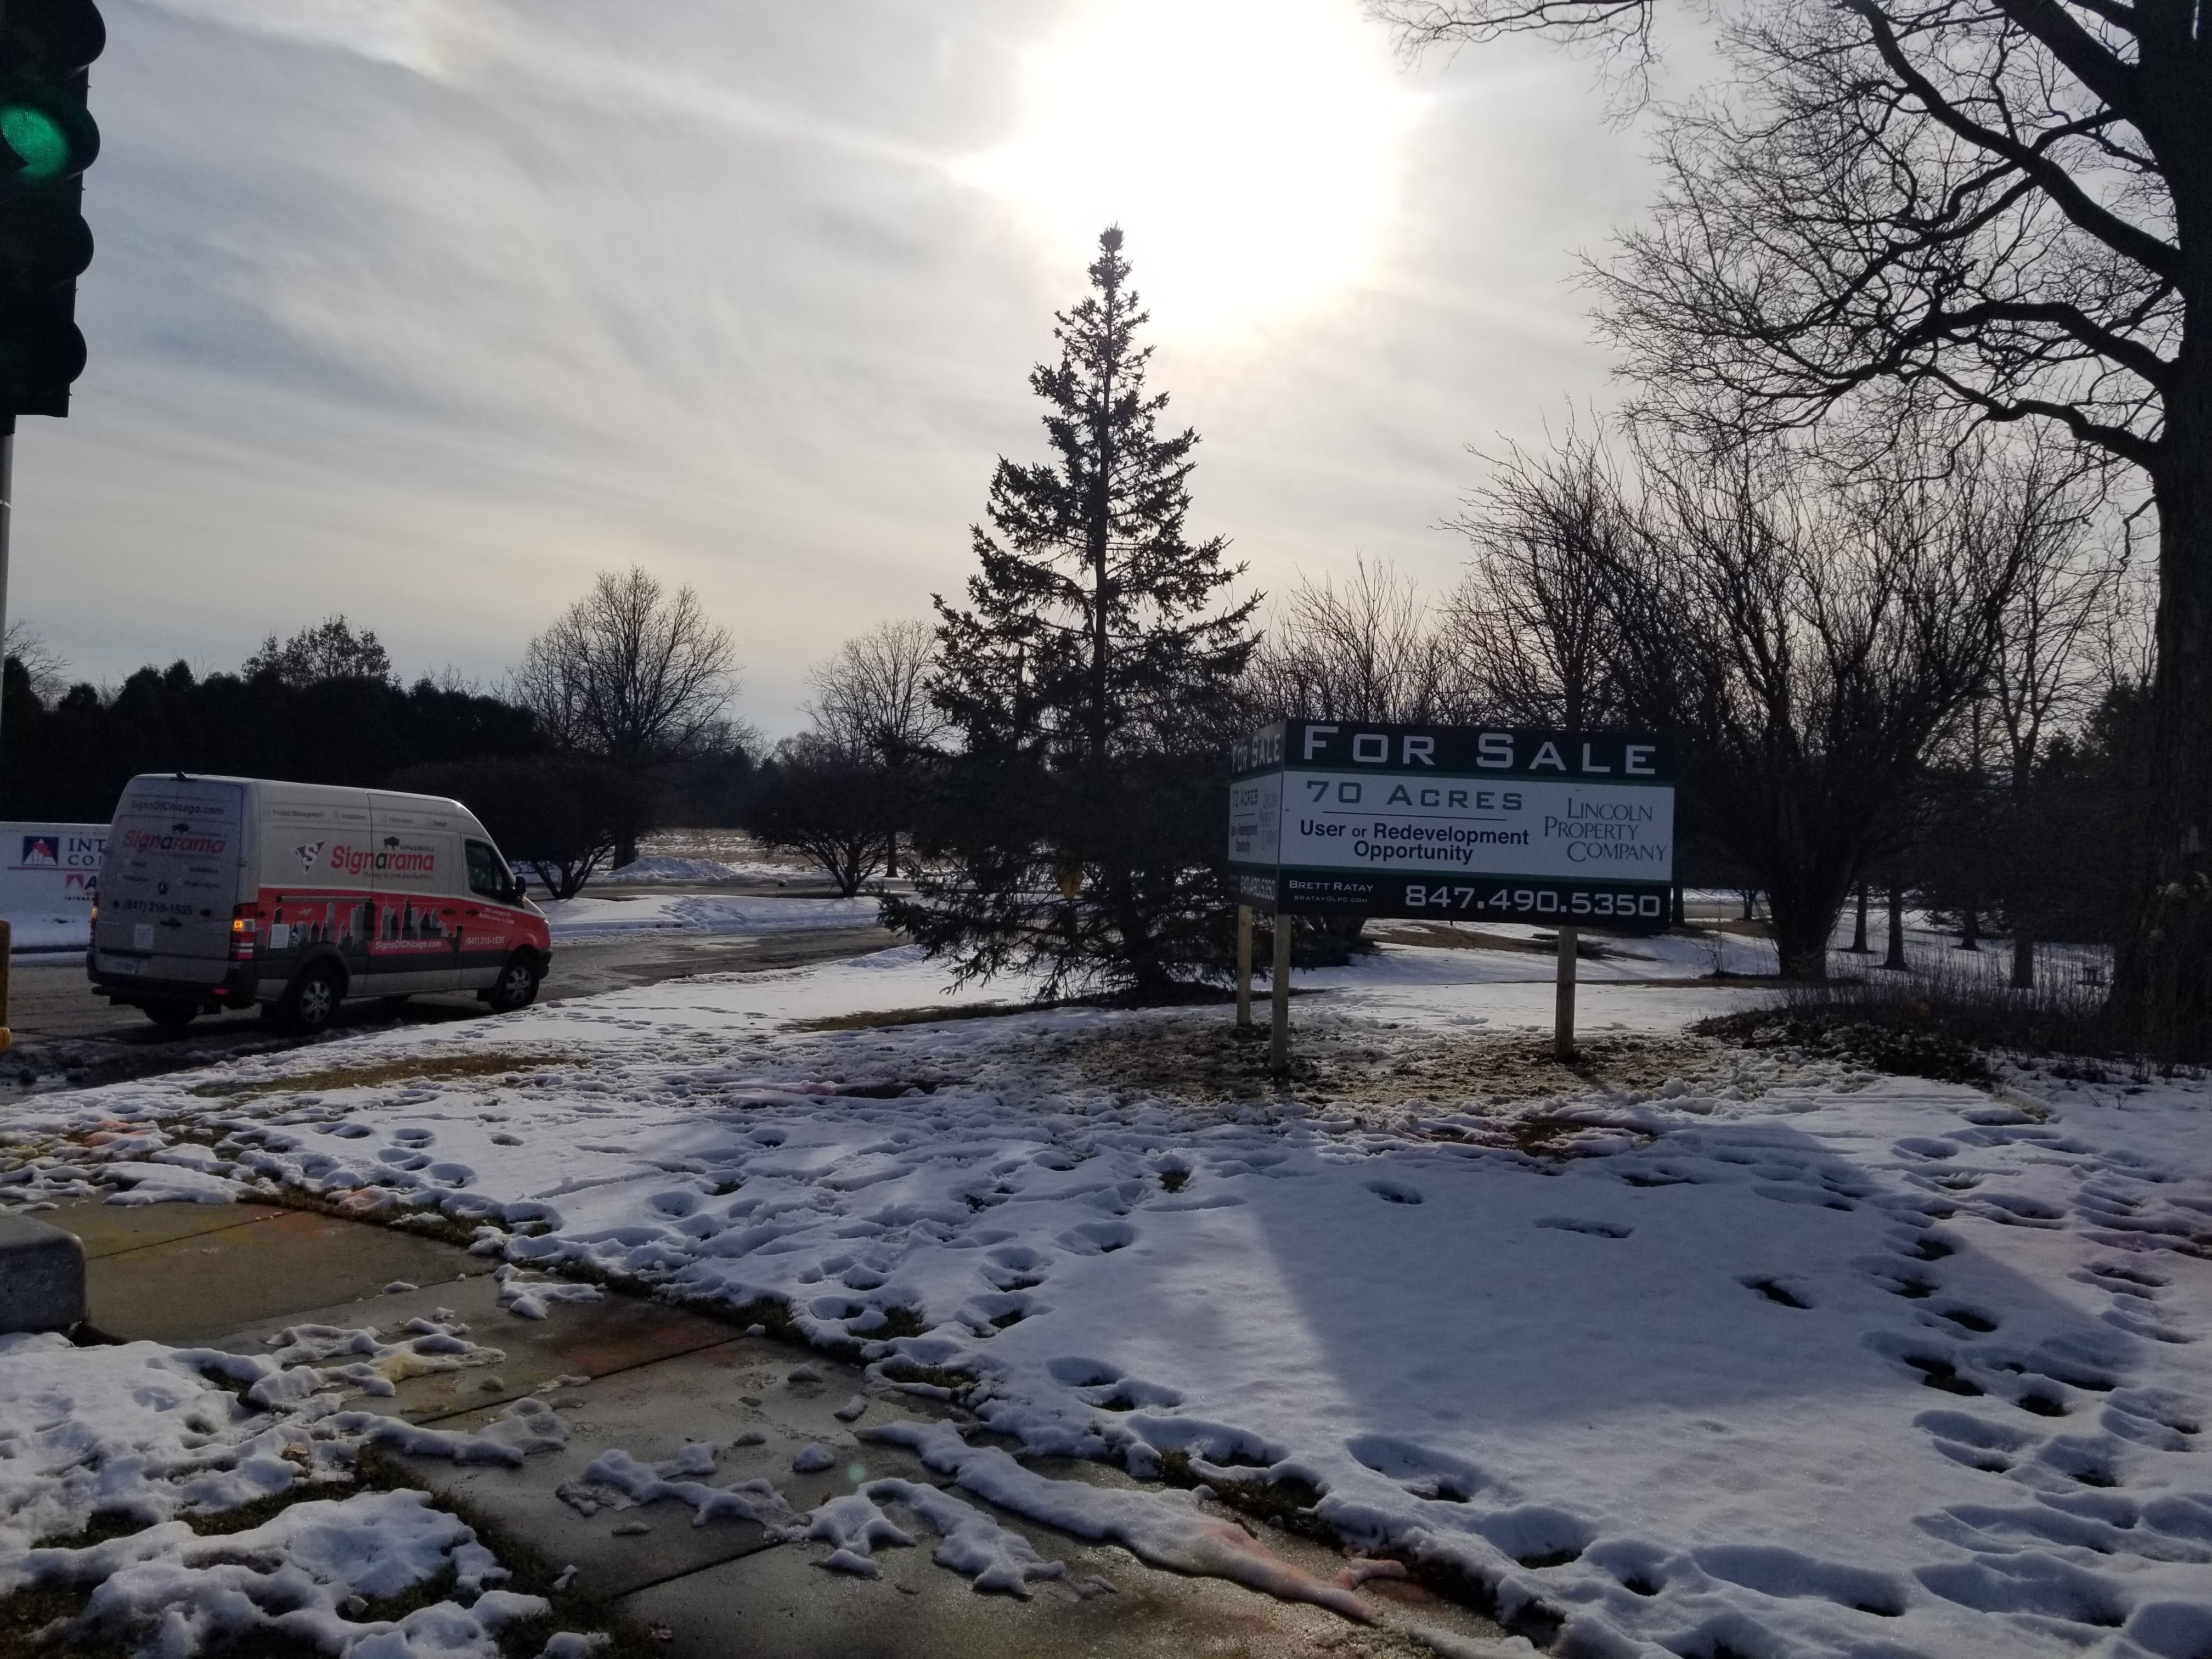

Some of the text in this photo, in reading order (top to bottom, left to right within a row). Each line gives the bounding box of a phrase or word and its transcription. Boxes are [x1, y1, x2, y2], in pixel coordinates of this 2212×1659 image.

[1232, 733, 1280, 774] FOR SALE
[1304, 725, 1657, 775] FOR SALE
[131, 800, 224, 815] SignsOfChicago.com
[1306, 780, 1362, 804] 70
[1386, 783, 1523, 811] ACRES
[1567, 797, 1654, 821] LINCOLN
[1300, 819, 1530, 849] User or Redevelopment
[1544, 815, 1639, 841] PROPERTY
[69, 838, 107, 853] INT
[1353, 840, 1474, 866] Opportunity
[1566, 841, 1668, 863] COMPANY
[331, 845, 435, 874] Signarama
[1289, 880, 1374, 891] BRETT RATAY
[1405, 884, 1661, 917] 847.490.5350
